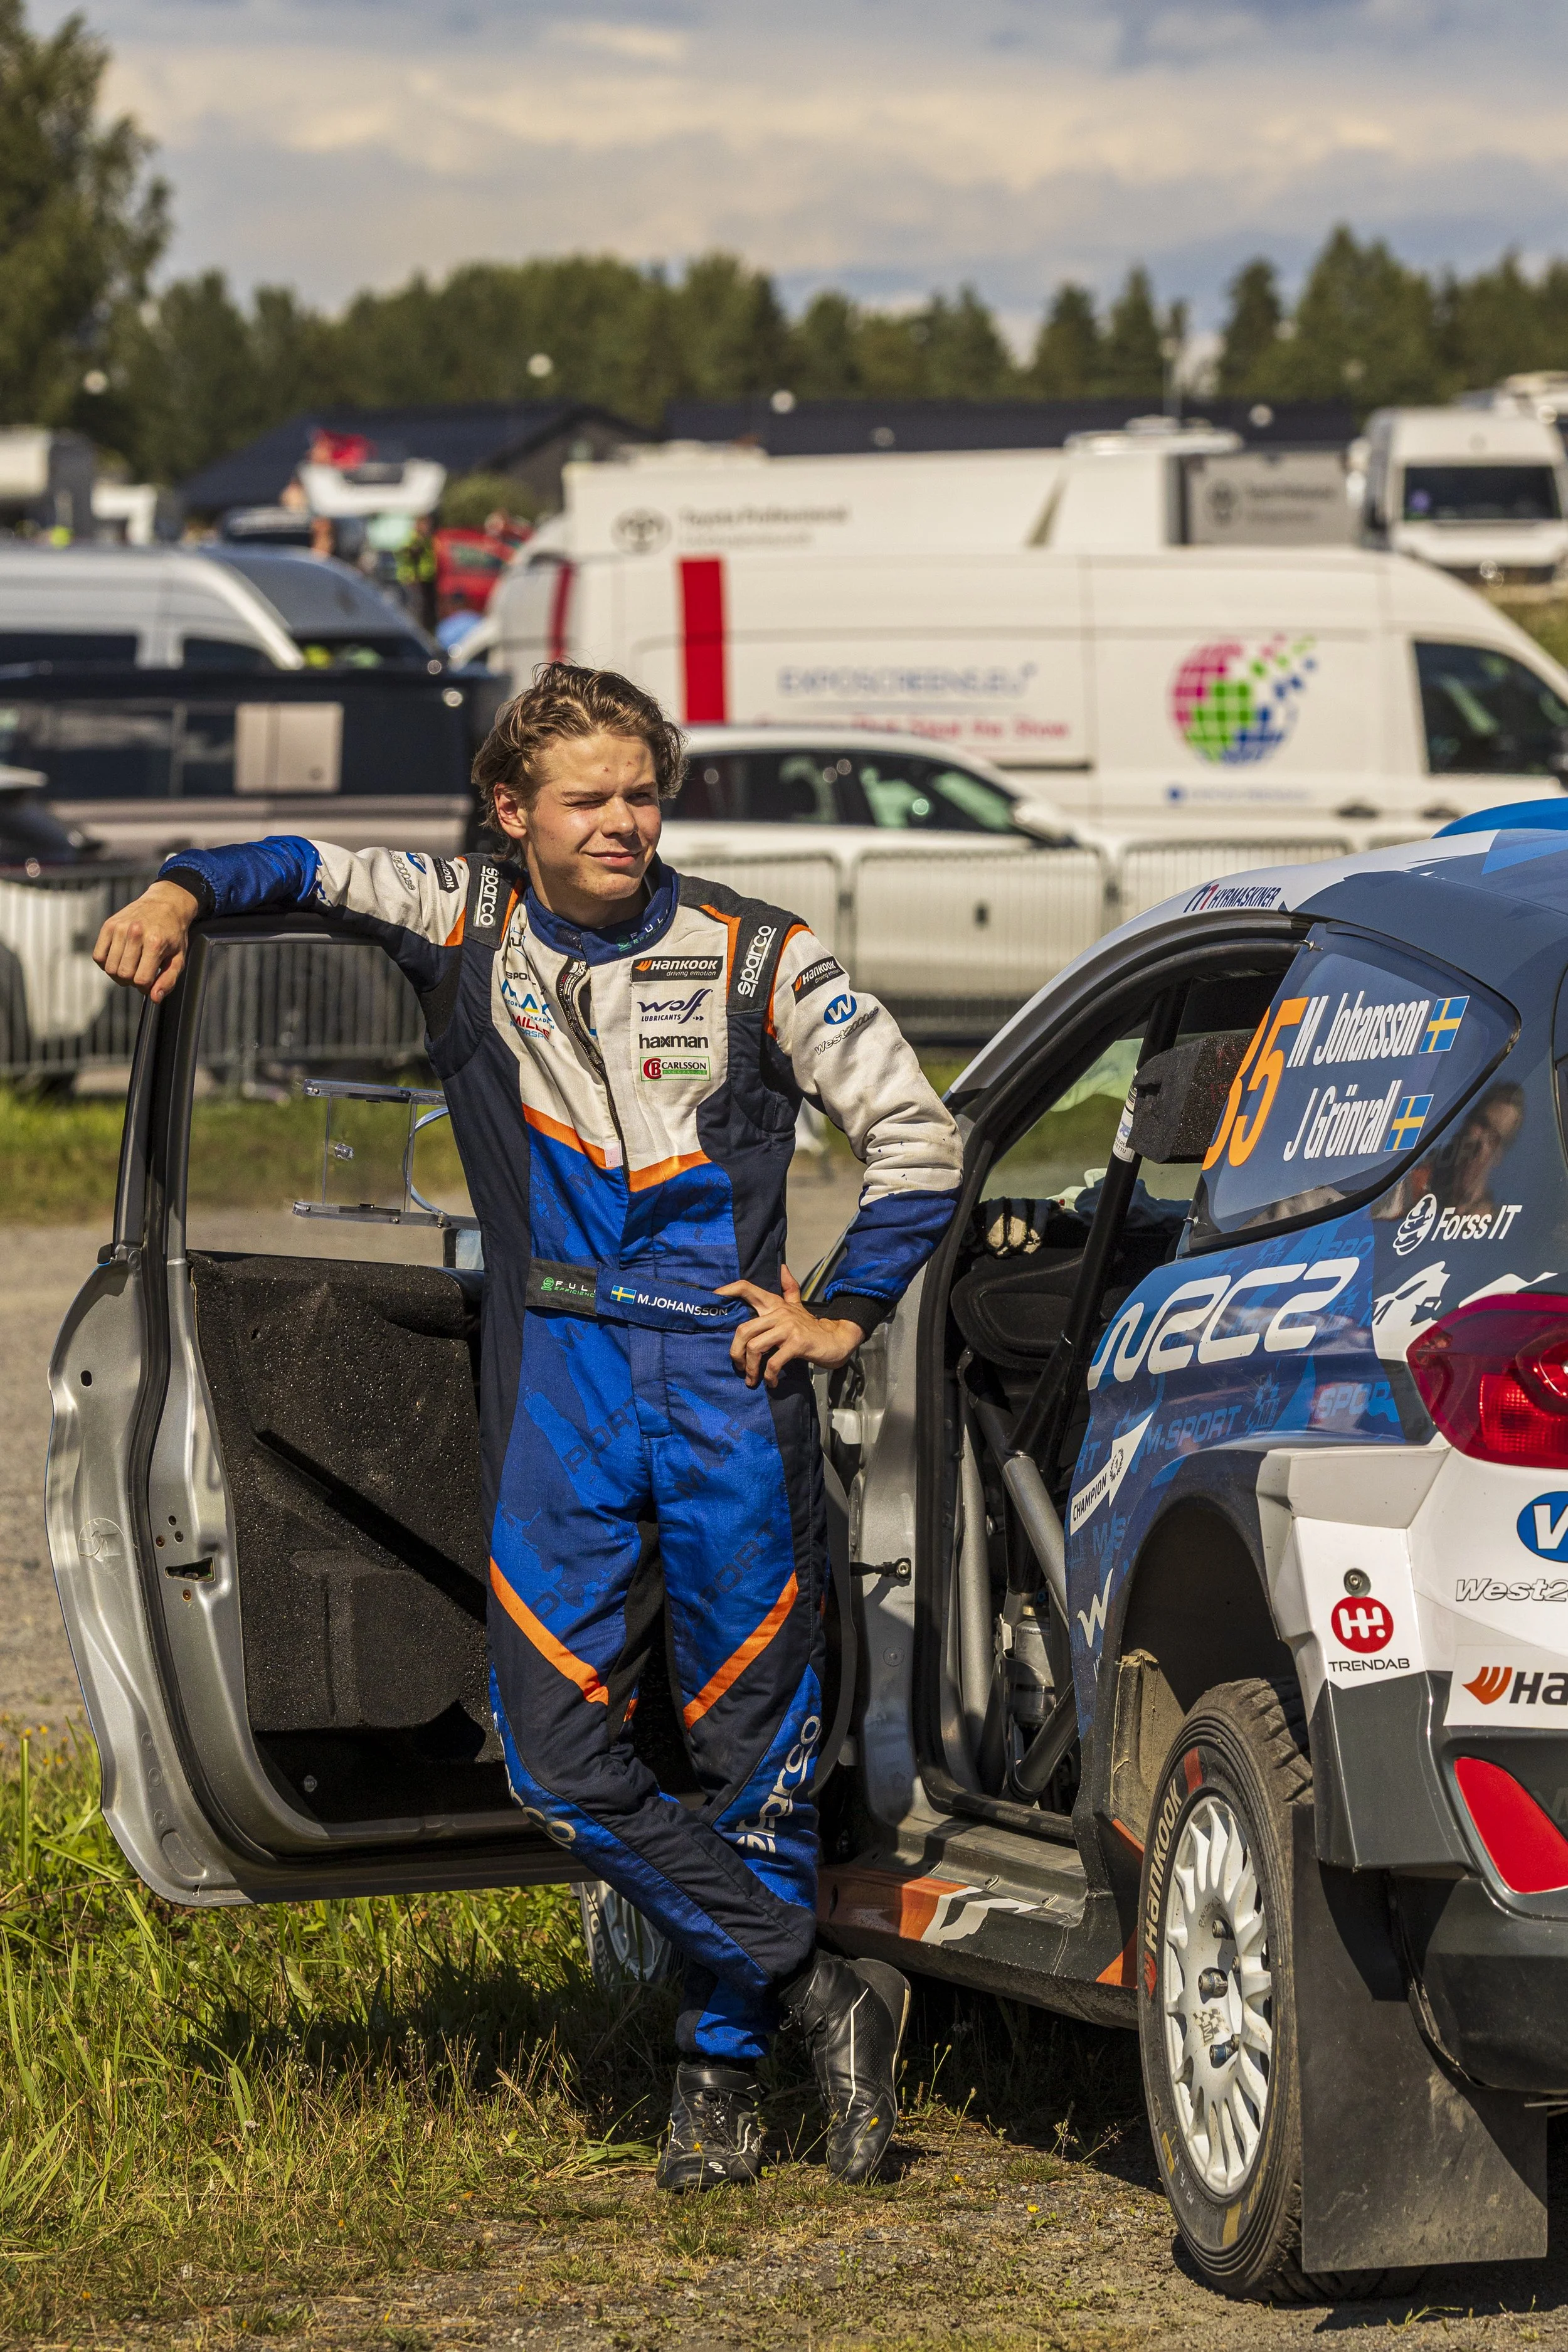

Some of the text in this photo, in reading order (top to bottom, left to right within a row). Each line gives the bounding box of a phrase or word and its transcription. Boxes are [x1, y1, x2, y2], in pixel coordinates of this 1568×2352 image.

[476, 866, 500, 926] sparco
[1207, 886, 1281, 909] HYRMASKINER
[737, 925, 776, 998] sparco
[827, 993, 852, 1022] W
[639, 1034, 709, 1049] haxman
[1286, 990, 1431, 1067] M Johansson
[1283, 1088, 1318, 1162] J
[1304, 1079, 1403, 1160] Grönvall
[1431, 1204, 1523, 1241] Forss IT
[554, 1286, 596, 1298] EFFICIENC
[637, 1293, 728, 1316] M.JOHANSSON
[1142, 1406, 1241, 1454] M-SPORT
[1073, 1473, 1107, 1522] CHAMPION
[1456, 1578, 1568, 1602] West2
[1328, 1658, 1410, 1672] TRENDAB
